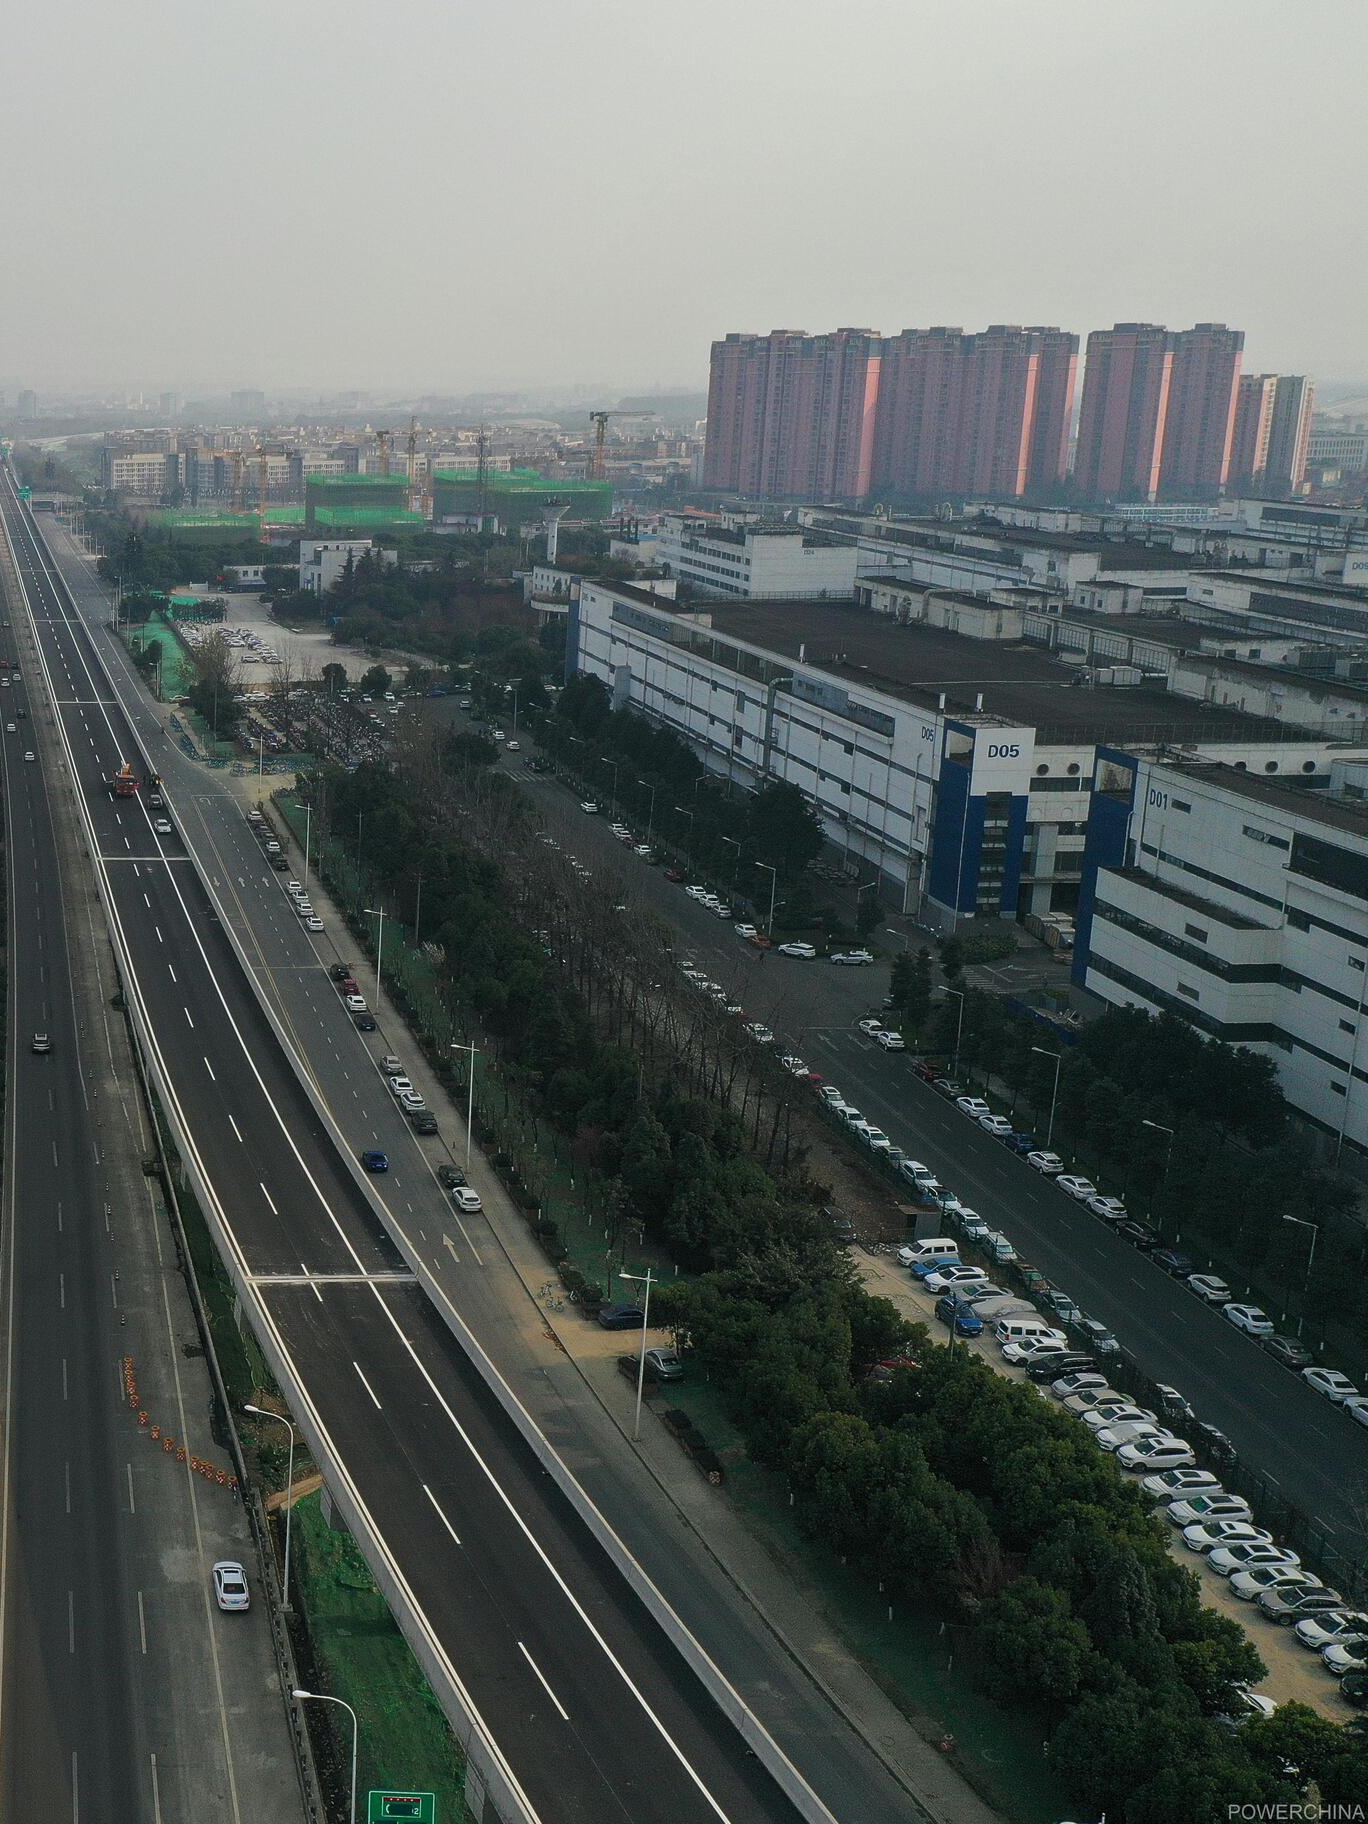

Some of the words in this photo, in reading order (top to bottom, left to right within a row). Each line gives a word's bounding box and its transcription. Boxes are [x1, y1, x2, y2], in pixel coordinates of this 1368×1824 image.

[921, 725, 934, 742] D05
[988, 744, 1020, 758] D05
[1149, 788, 1168, 811] D01
